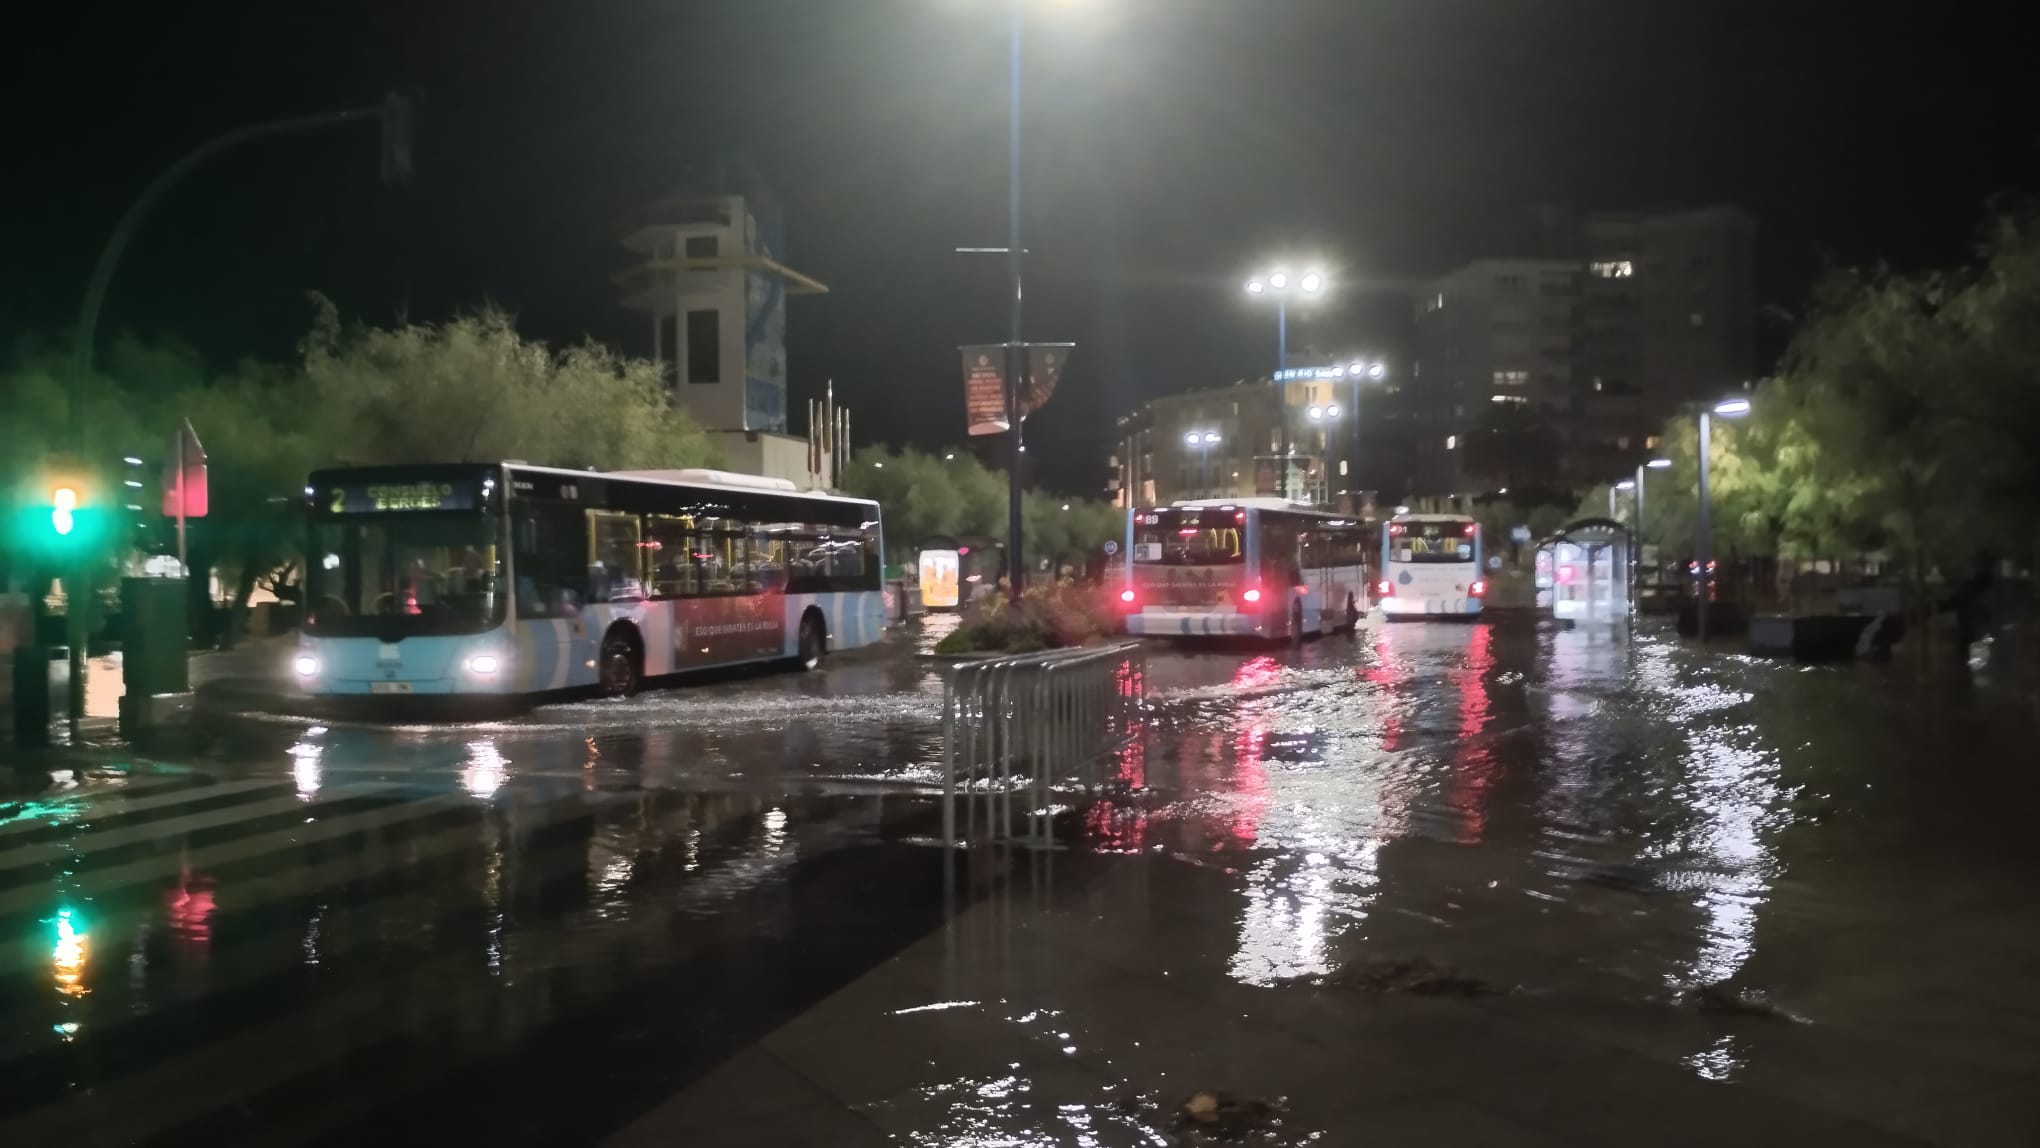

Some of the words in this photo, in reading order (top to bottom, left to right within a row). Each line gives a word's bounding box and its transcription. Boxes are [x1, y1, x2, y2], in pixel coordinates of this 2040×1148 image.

[329, 487, 346, 513] 2
[1145, 514, 1159, 525] 89
[695, 626, 708, 637] ESO
[709, 625, 722, 637] QUE
